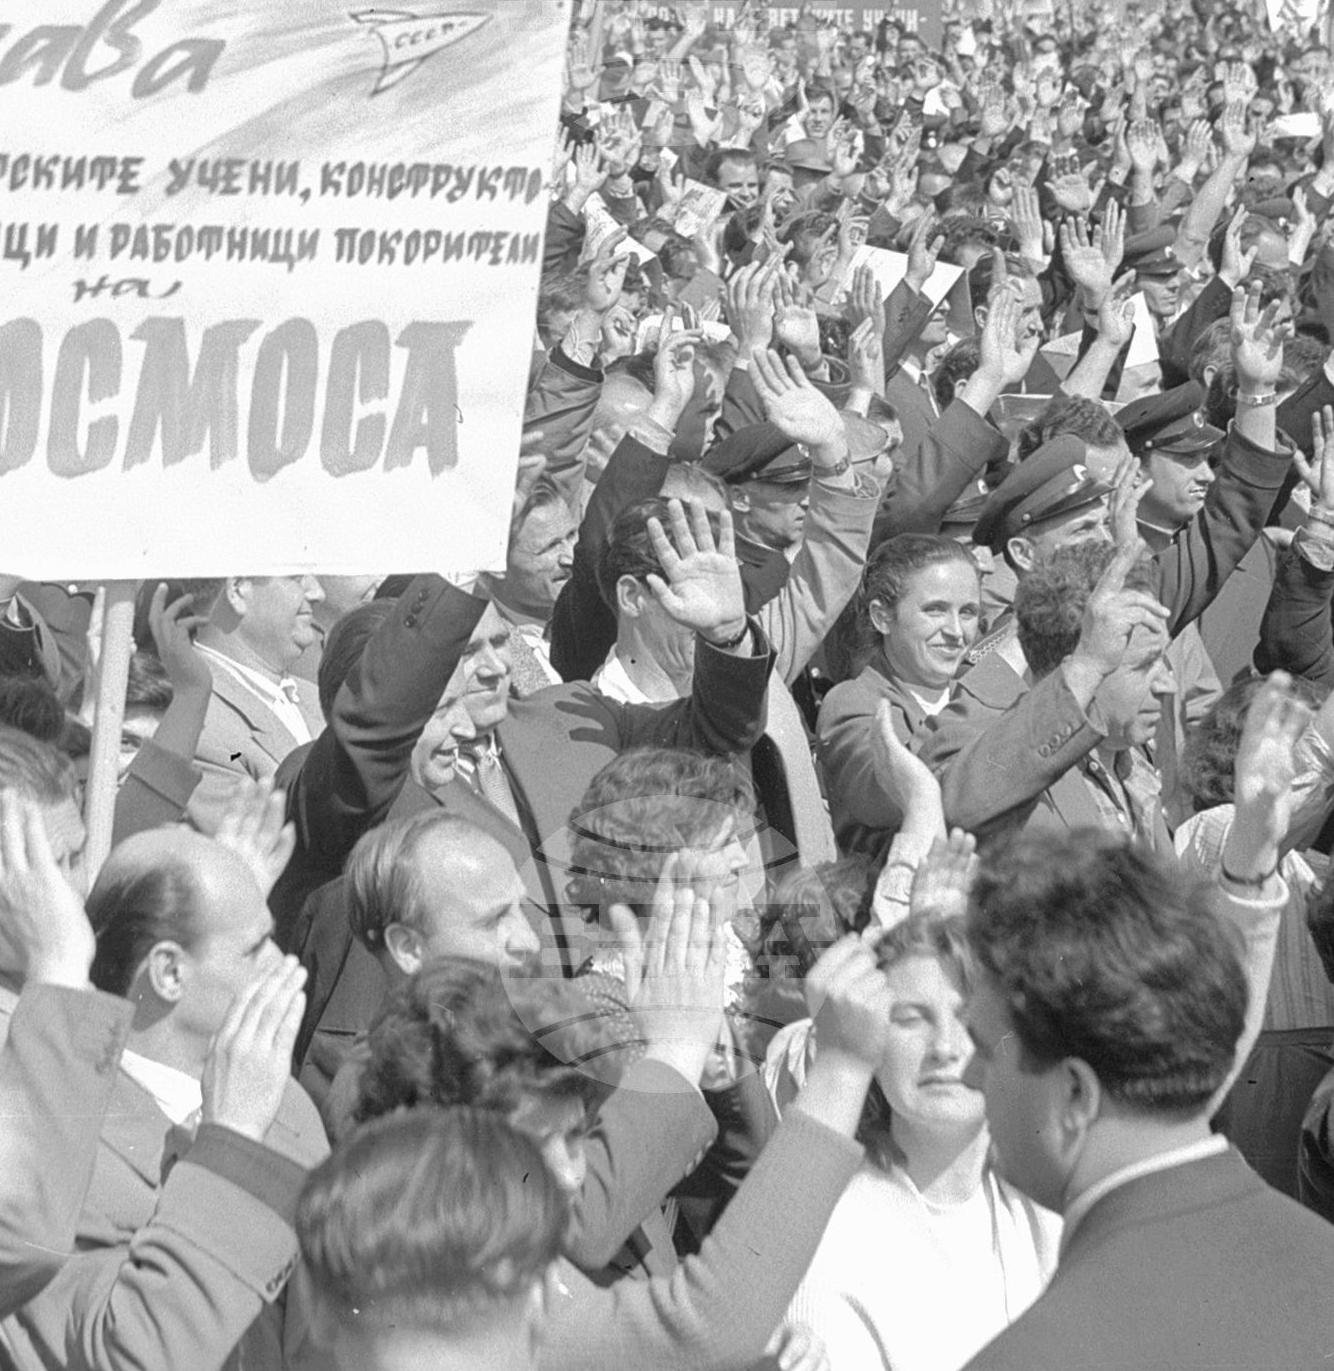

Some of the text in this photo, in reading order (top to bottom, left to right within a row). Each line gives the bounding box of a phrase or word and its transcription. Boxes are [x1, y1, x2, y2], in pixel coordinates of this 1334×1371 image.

[166, 156, 312, 204] УЧЕНИ,
[73, 225, 98, 262] И
[109, 225, 319, 272] РАБОТНИЦИ
[335, 227, 541, 269] ПОКОРИТЕЛИ
[72, 275, 183, 303] на
